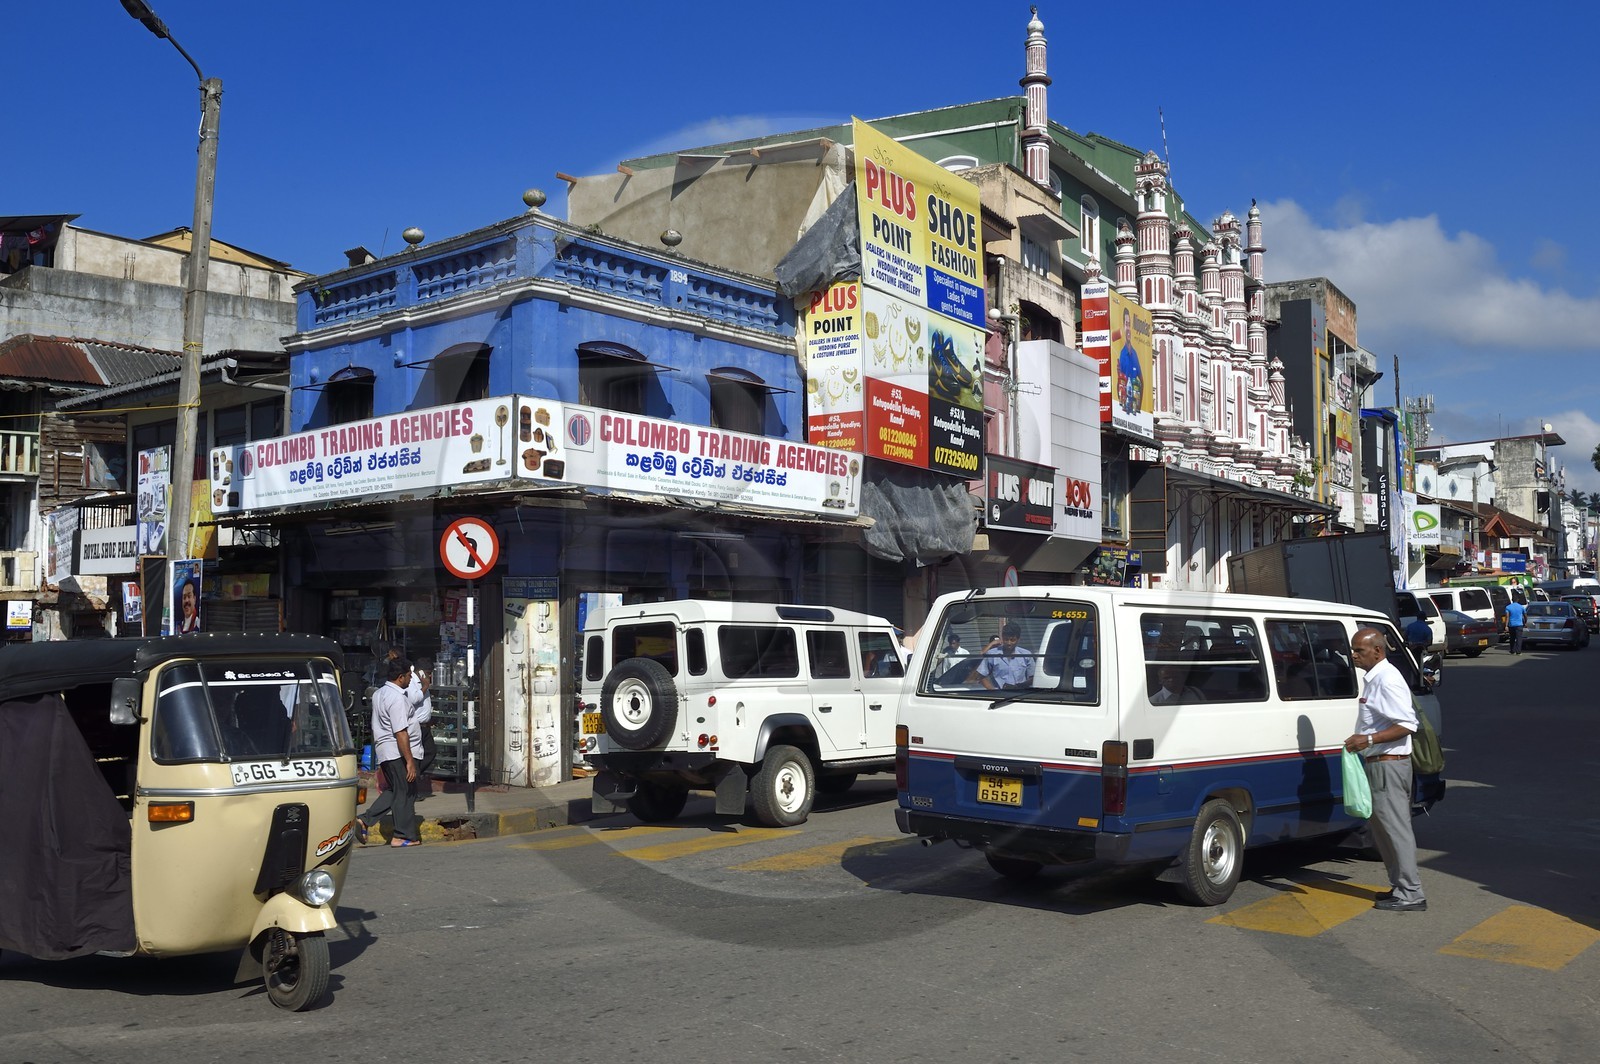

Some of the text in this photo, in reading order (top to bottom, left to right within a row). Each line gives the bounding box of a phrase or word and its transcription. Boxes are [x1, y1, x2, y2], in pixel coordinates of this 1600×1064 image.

[864, 156, 917, 221] PLUS
[927, 193, 977, 253] SHOE
[872, 213, 912, 255] POINT
[865, 241, 922, 278] DEALERS IN FANCY GOODS,
[931, 240, 977, 280] FASHION
[670, 269, 688, 285] 1894
[877, 258, 914, 283] WEDDING PURSE
[871, 269, 921, 298] & COSTUME JEWELLERY
[933, 270, 977, 298] Specialist in imported
[1084, 287, 1107, 295] Nippolac
[810, 284, 857, 315] PLUS
[946, 289, 965, 304] Ladies &
[941, 301, 973, 321] gents Footware
[814, 316, 853, 335] POINT
[809, 334, 860, 346] DEALERS IN FANCY GOODS,
[818, 341, 851, 352] WEDDING PURSE
[817, 350, 835, 359] COSTUME
[835, 348, 857, 357] JEWELLERY
[889, 412, 905, 428] Kandy
[257, 406, 474, 470] COLOMBO TRADING AGENCIES
[827, 429, 843, 438] Kandy
[879, 426, 917, 448] 0812200846
[949, 433, 965, 449] Kandy
[600, 414, 848, 477] COLOMBO TRADING AGENCIES
[990, 470, 1054, 508] PLUS POINT
[1379, 474, 1387, 517] Casual
[83, 543, 100, 560] ROYAL
[101, 541, 117, 559] SHOE
[1052, 610, 1088, 619] 54-6552
[586, 724, 603, 734] 1193
[982, 764, 1009, 773] TOYOTA
[981, 789, 1019, 804] 6552
